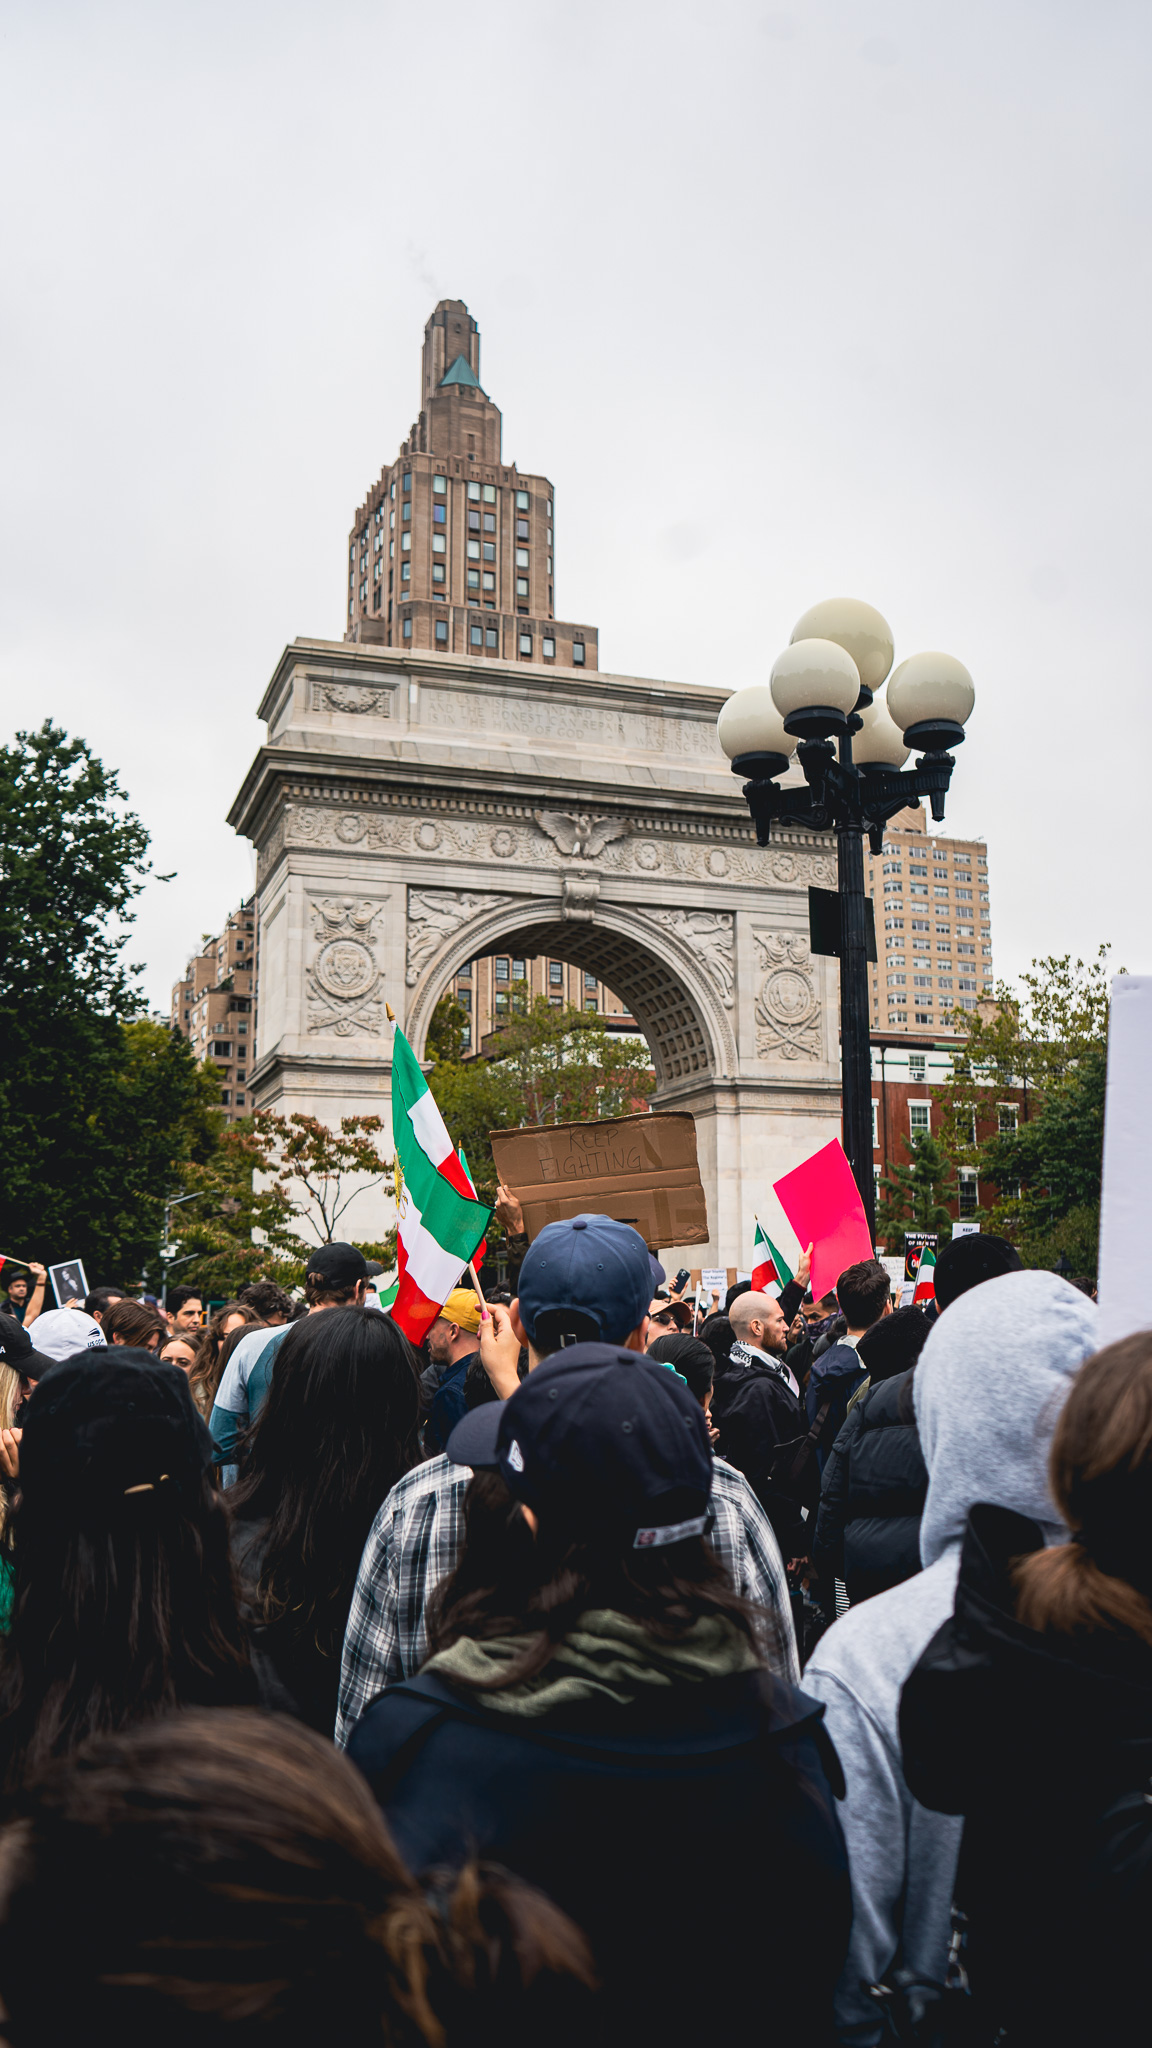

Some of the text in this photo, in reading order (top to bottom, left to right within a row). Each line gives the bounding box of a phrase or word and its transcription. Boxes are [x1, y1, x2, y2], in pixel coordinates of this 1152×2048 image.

[428, 691, 451, 702] LET
[455, 693, 470, 705] US
[474, 695, 509, 709] RAISE
[527, 702, 593, 719] STANDARD
[597, 711, 613, 721] TO
[617, 712, 656, 726] WHICH
[660, 718, 683, 728] THE
[688, 722, 716, 734] WISE
[429, 702, 717, 742] AND THE HONEST CAN REPAIR THE EVENT
[428, 713, 717, 753] IS IN THE HAND OF GOD WASHINGTON
[569, 1127, 618, 1152] KEEP
[539, 1146, 641, 1180] FIGHTING
